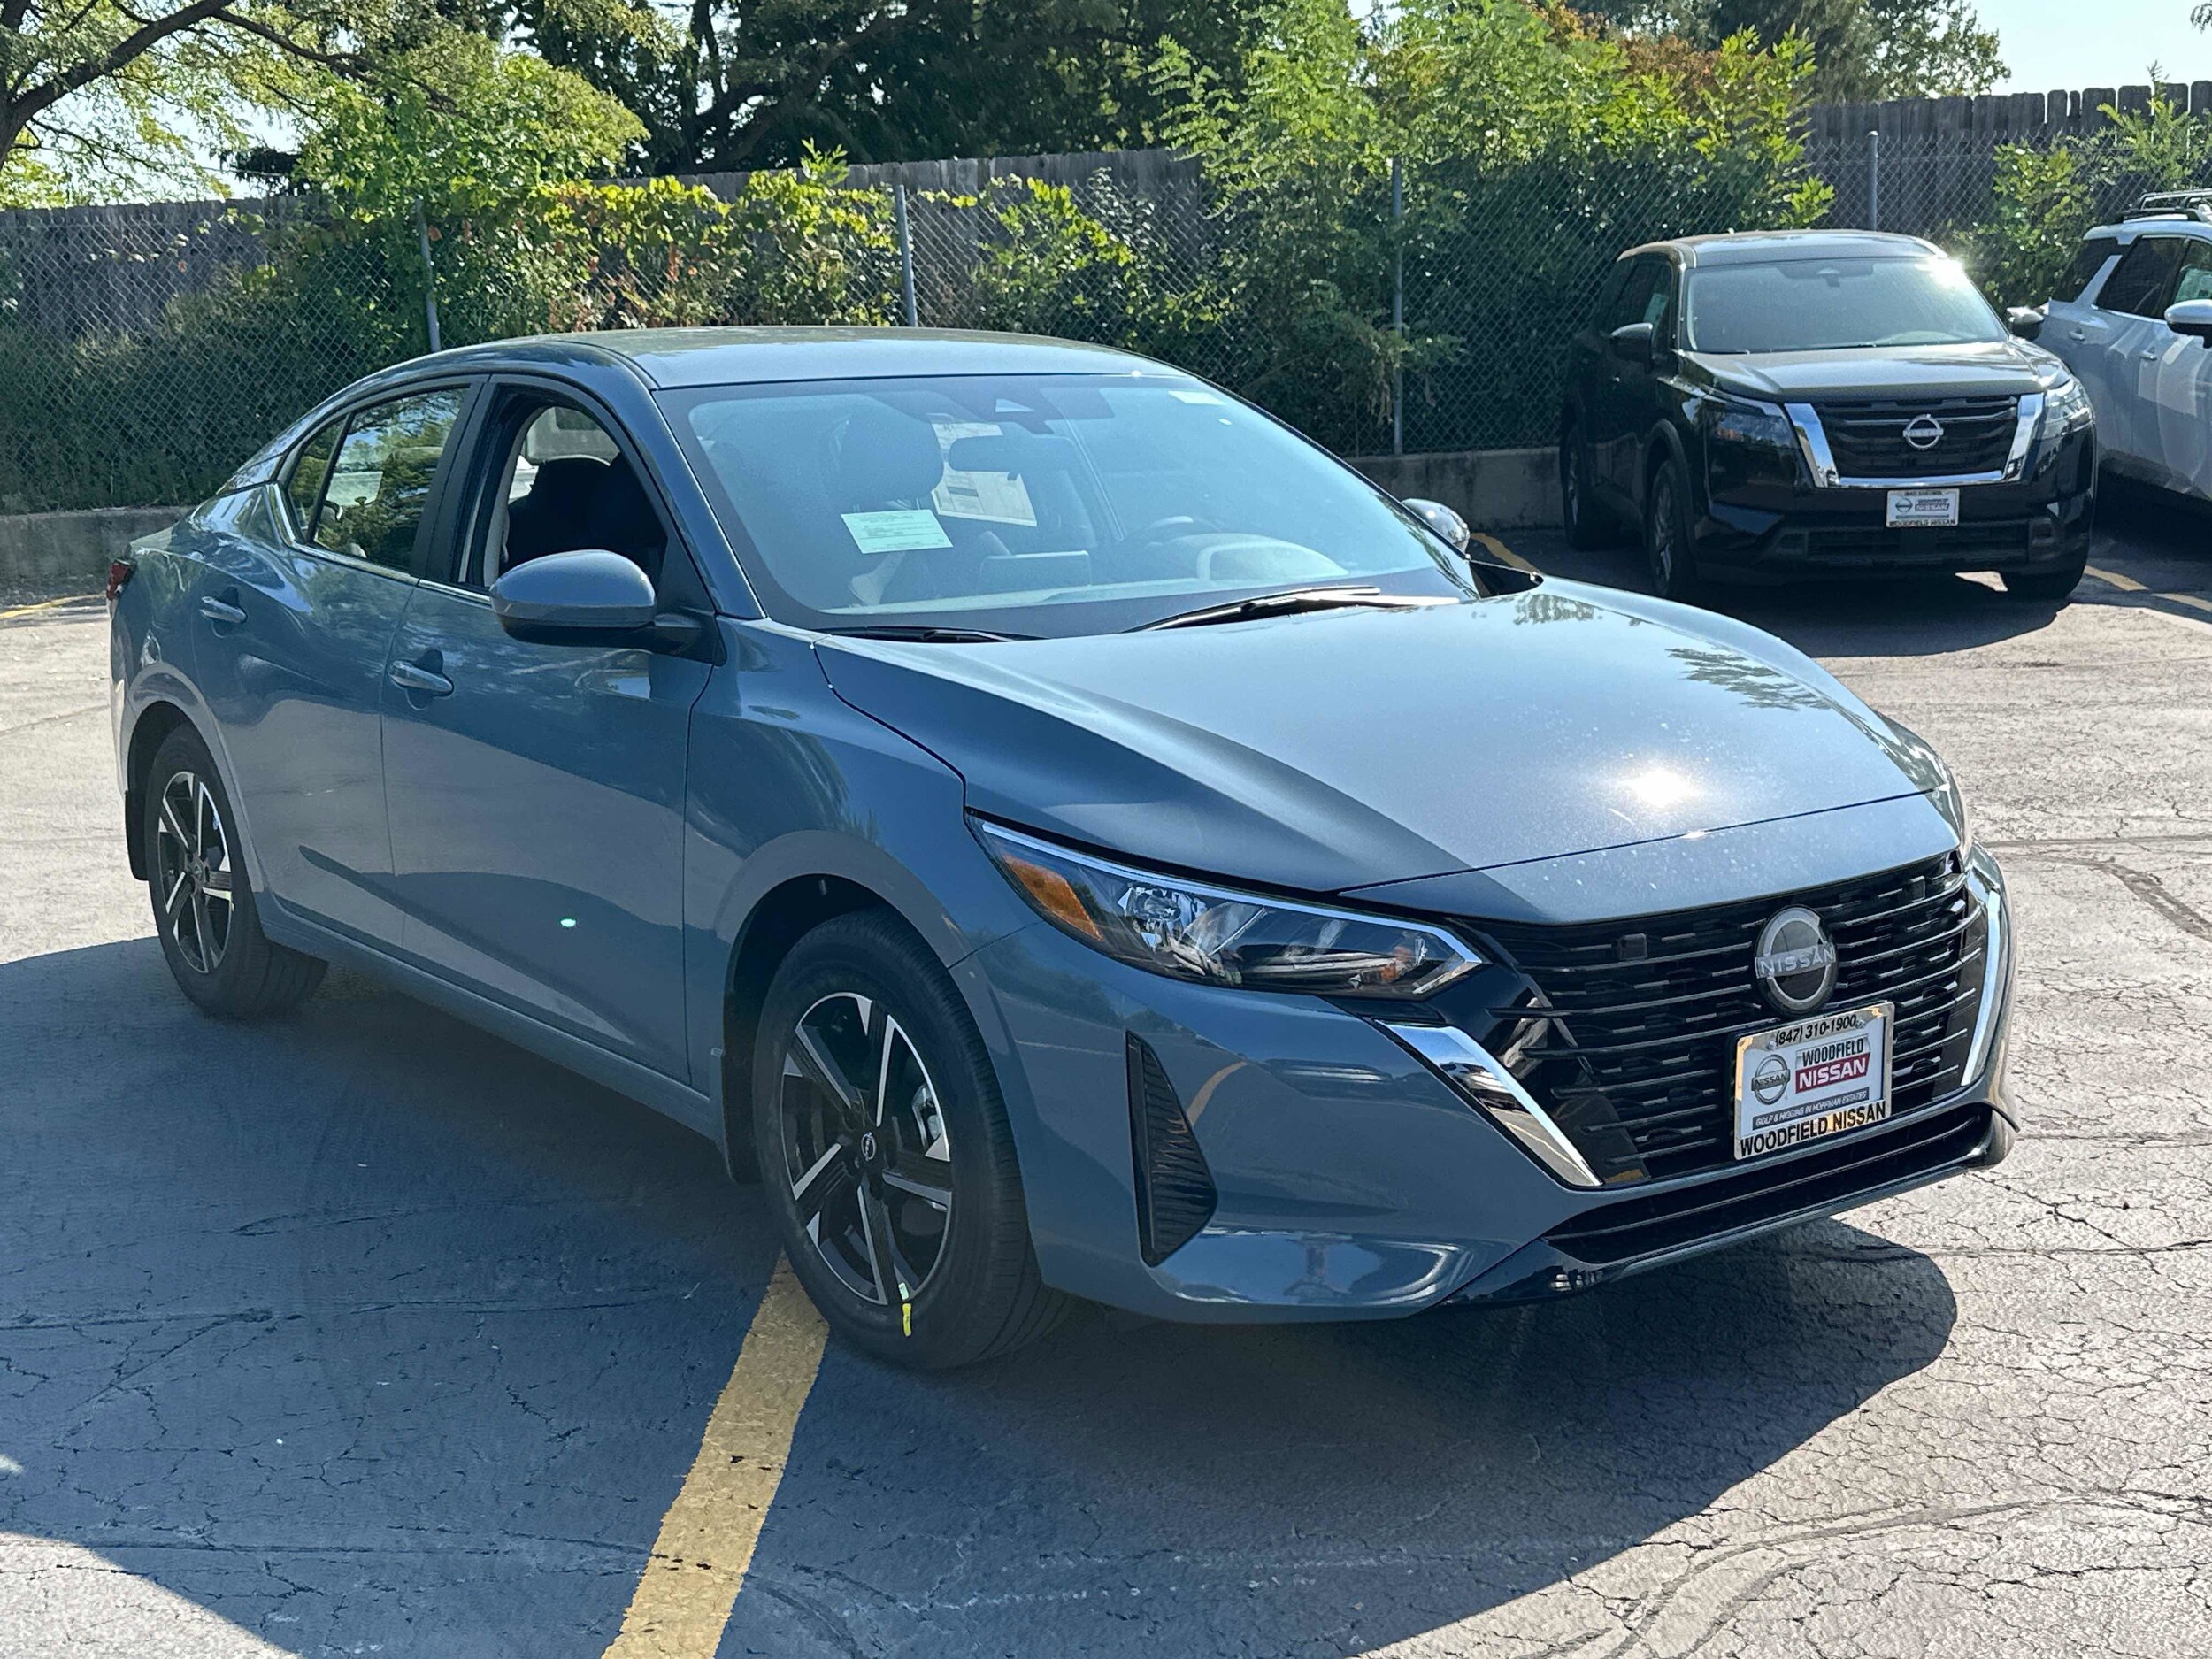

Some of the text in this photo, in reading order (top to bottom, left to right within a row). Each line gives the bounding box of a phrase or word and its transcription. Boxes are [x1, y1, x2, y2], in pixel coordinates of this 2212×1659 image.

[1760, 945, 1835, 975] NISSAN
[1776, 1014, 1857, 1045] (847) 310-1900
[1802, 1037, 1864, 1067] WOODFIELD
[1754, 1071, 1788, 1087] NISSAN
[1799, 1058, 1866, 1089] NISSAN
[1755, 1115, 1774, 1126] GOLF
[1805, 1104, 1812, 1114] IN
[1812, 1097, 1841, 1111] HOFFMAN
[1841, 1090, 1867, 1103] ESTATES
[1740, 1101, 1886, 1157] WOODFIELD NISSAN
